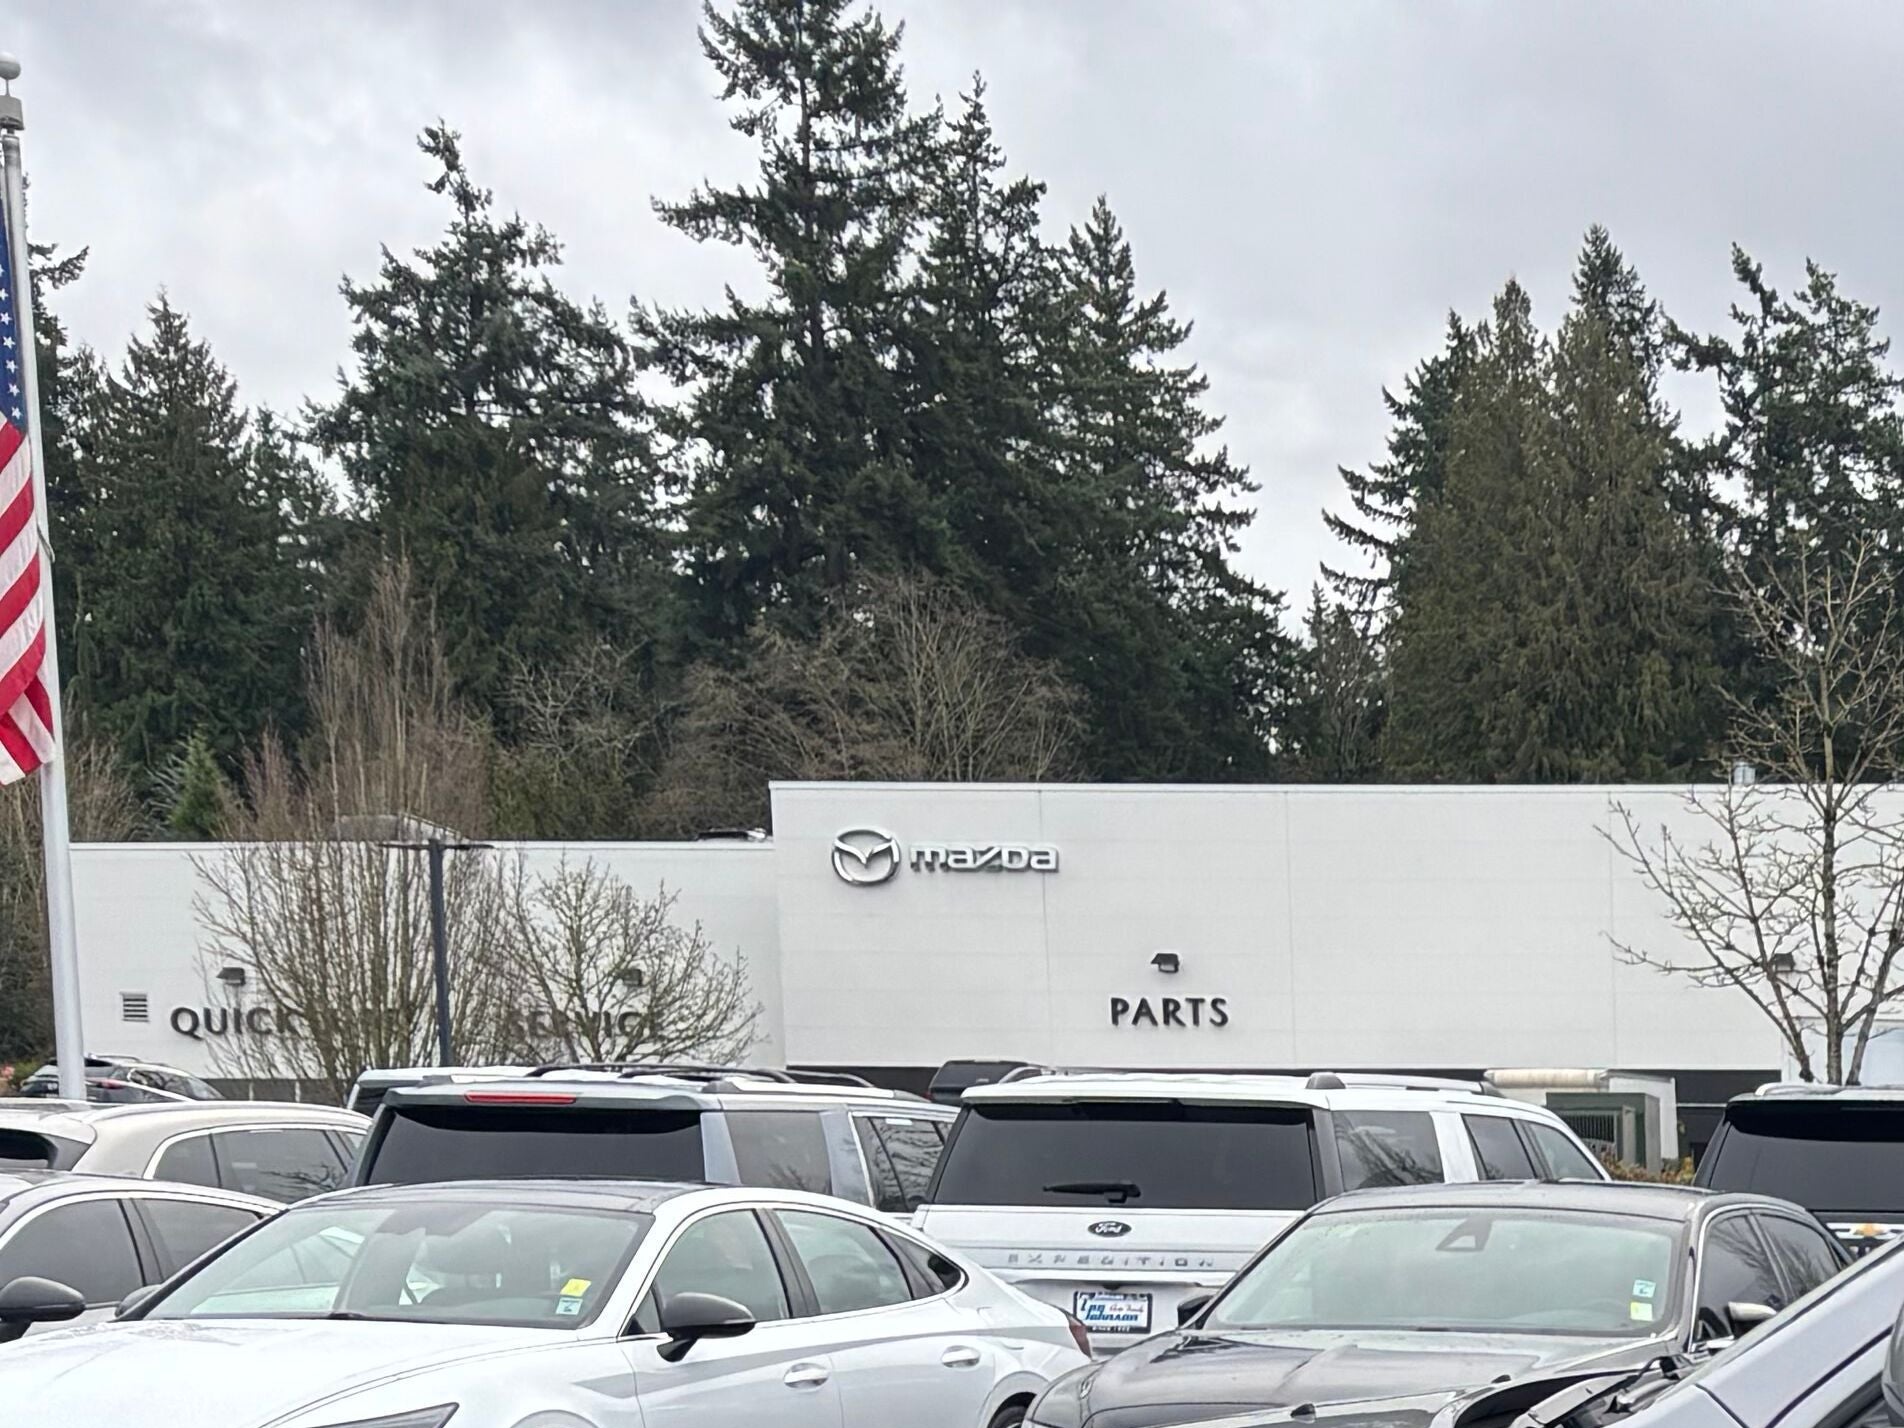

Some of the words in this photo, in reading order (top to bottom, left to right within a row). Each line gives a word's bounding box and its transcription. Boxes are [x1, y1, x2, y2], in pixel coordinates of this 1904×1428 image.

[908, 842, 1060, 873] mazda
[169, 1006, 301, 1040] QUICK
[1110, 996, 1230, 1029] PARTS
